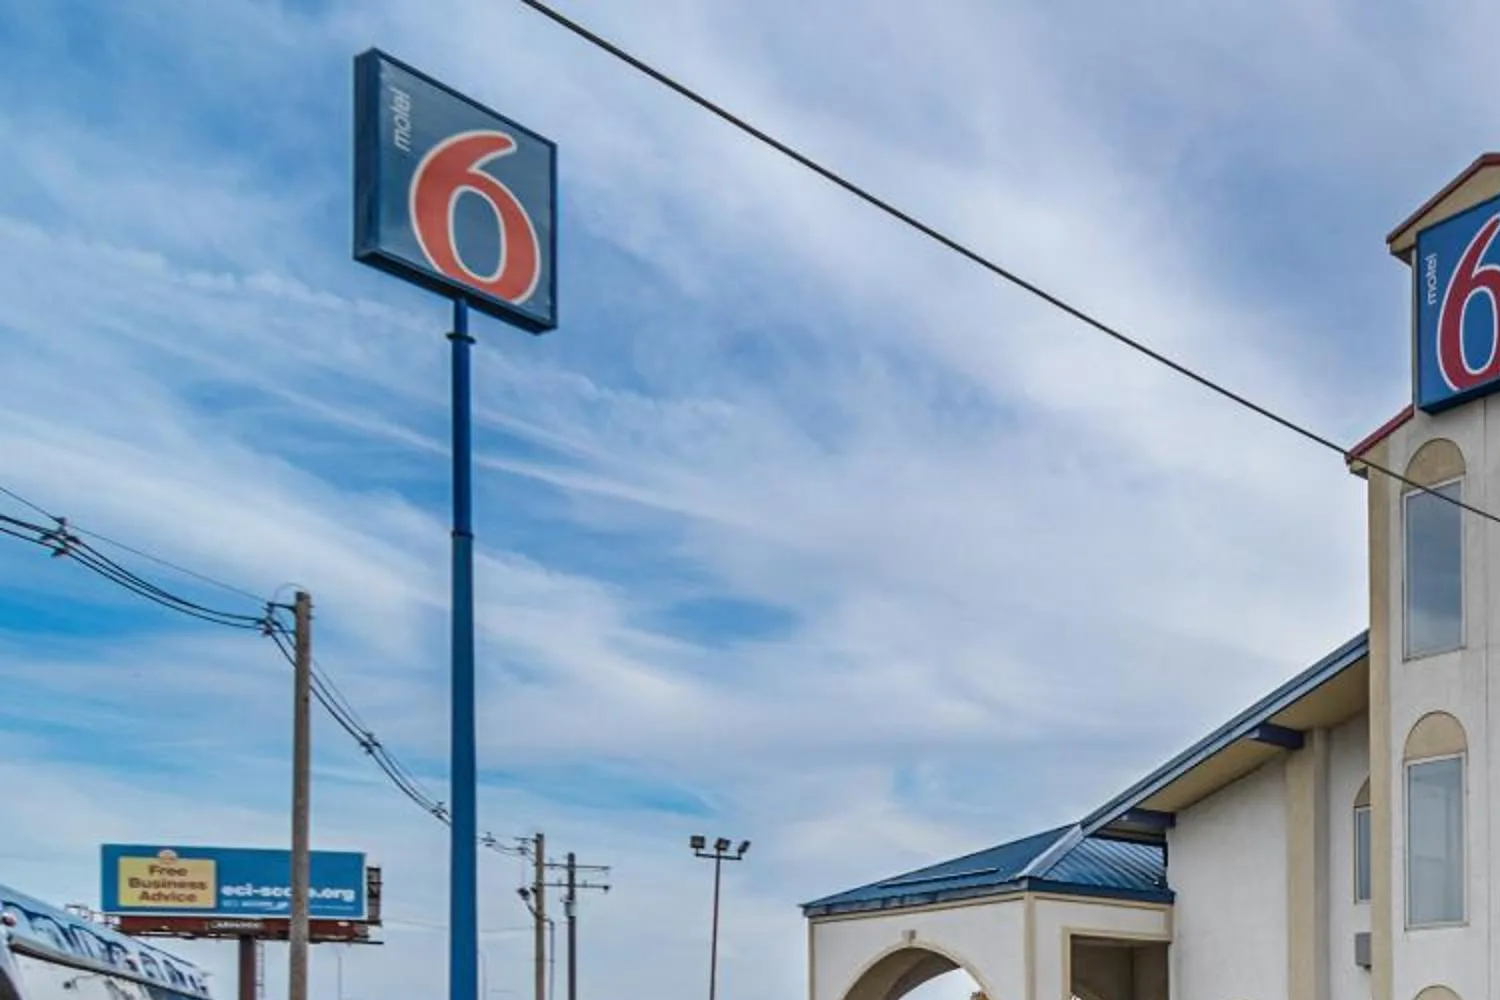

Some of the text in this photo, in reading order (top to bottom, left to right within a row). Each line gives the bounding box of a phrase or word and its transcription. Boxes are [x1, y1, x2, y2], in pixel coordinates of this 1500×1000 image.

[389, 86, 411, 152] motel
[409, 130, 541, 305] 6
[1424, 253, 1438, 305] motel
[128, 877, 208, 891] Business
[148, 864, 188, 877] Free
[138, 891, 198, 903] Advice
